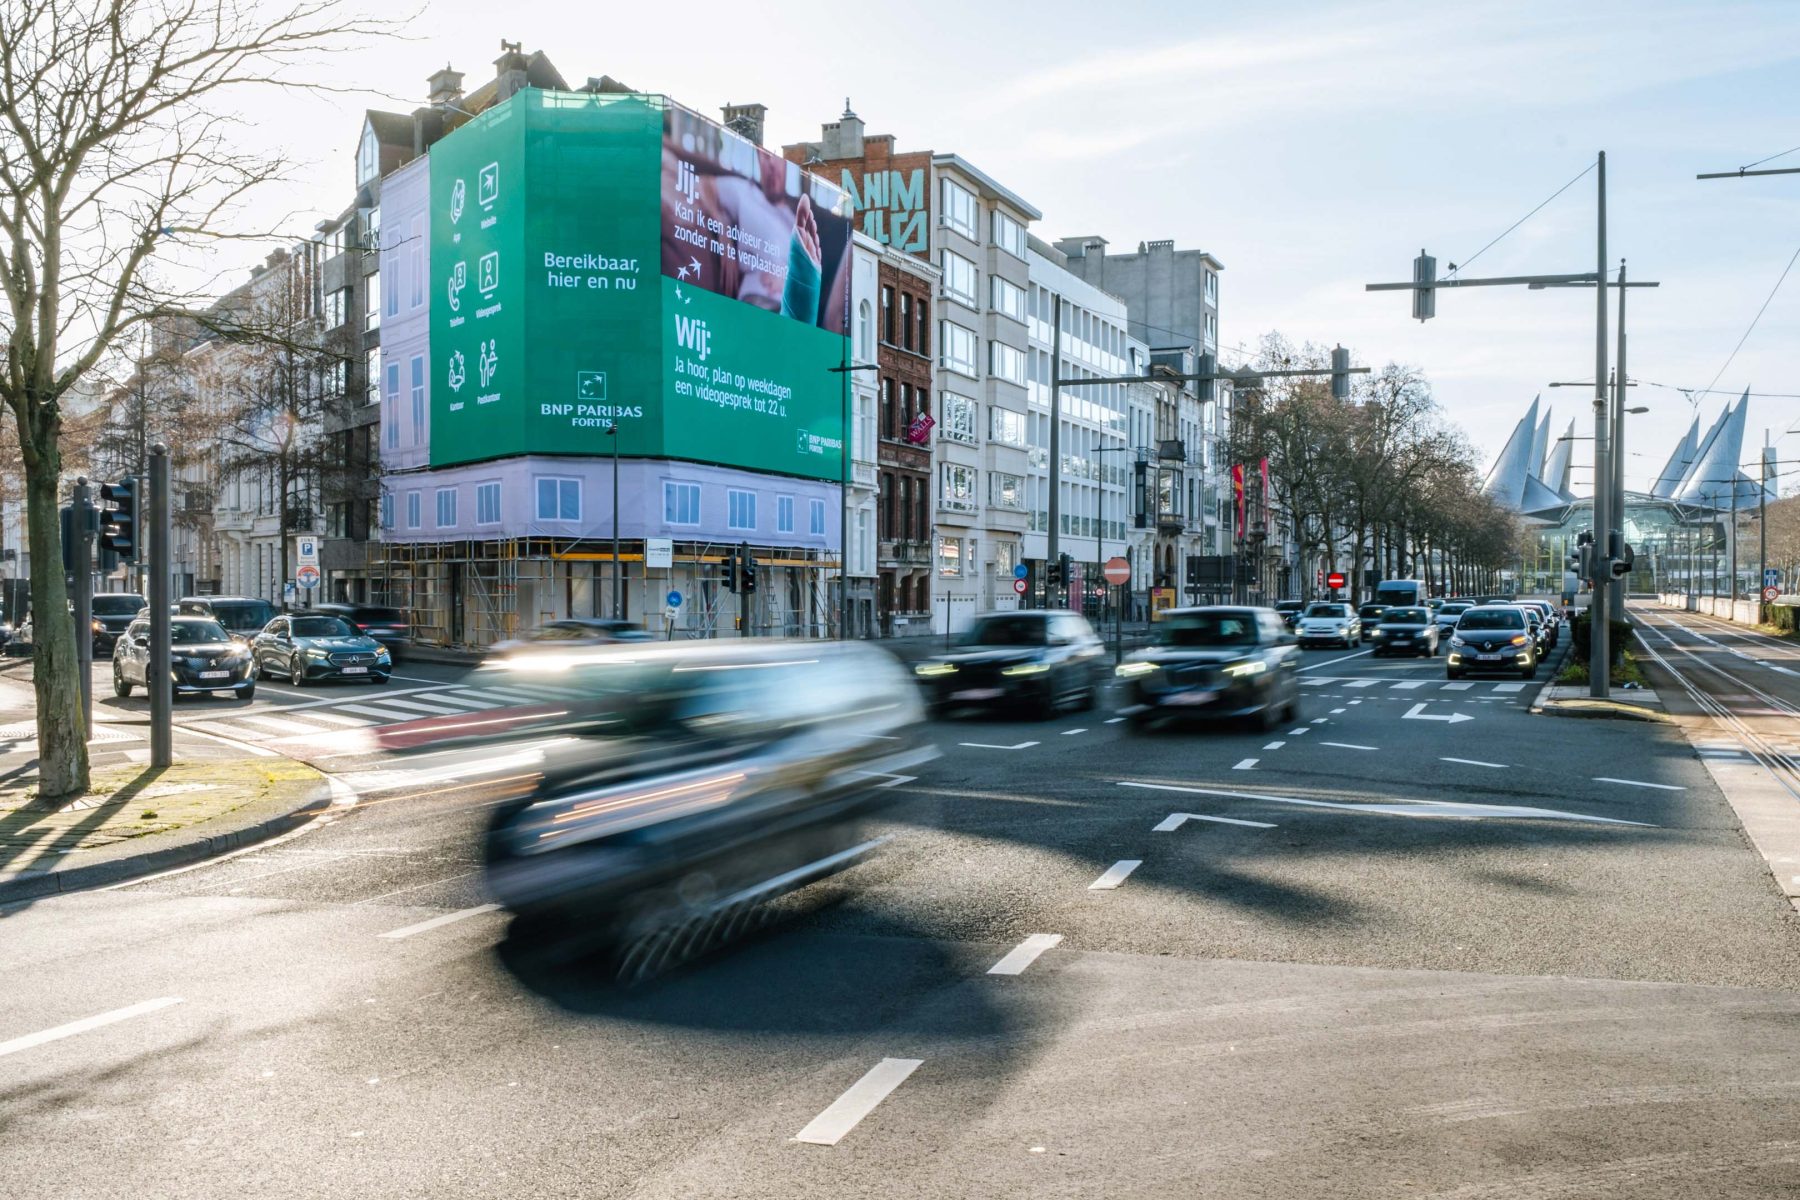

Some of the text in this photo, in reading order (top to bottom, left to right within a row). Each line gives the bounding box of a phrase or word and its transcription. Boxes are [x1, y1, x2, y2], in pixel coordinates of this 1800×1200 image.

[675, 159, 700, 205] Jij:
[841, 167, 924, 212] ANIM
[675, 200, 781, 257] Kan ik een adviseur zien
[544, 252, 640, 274] Bereikbaar,
[674, 225, 789, 278] zonder me te verplaatsen?
[548, 271, 637, 290] hier en nu
[674, 313, 711, 361] Wij:
[674, 355, 792, 401] Ja hoor, plan op weekdagen
[675, 380, 787, 417] een videogesprek tot 22 u.
[541, 403, 643, 418] BNP PARIBAS
[571, 418, 613, 429] FORTIS
